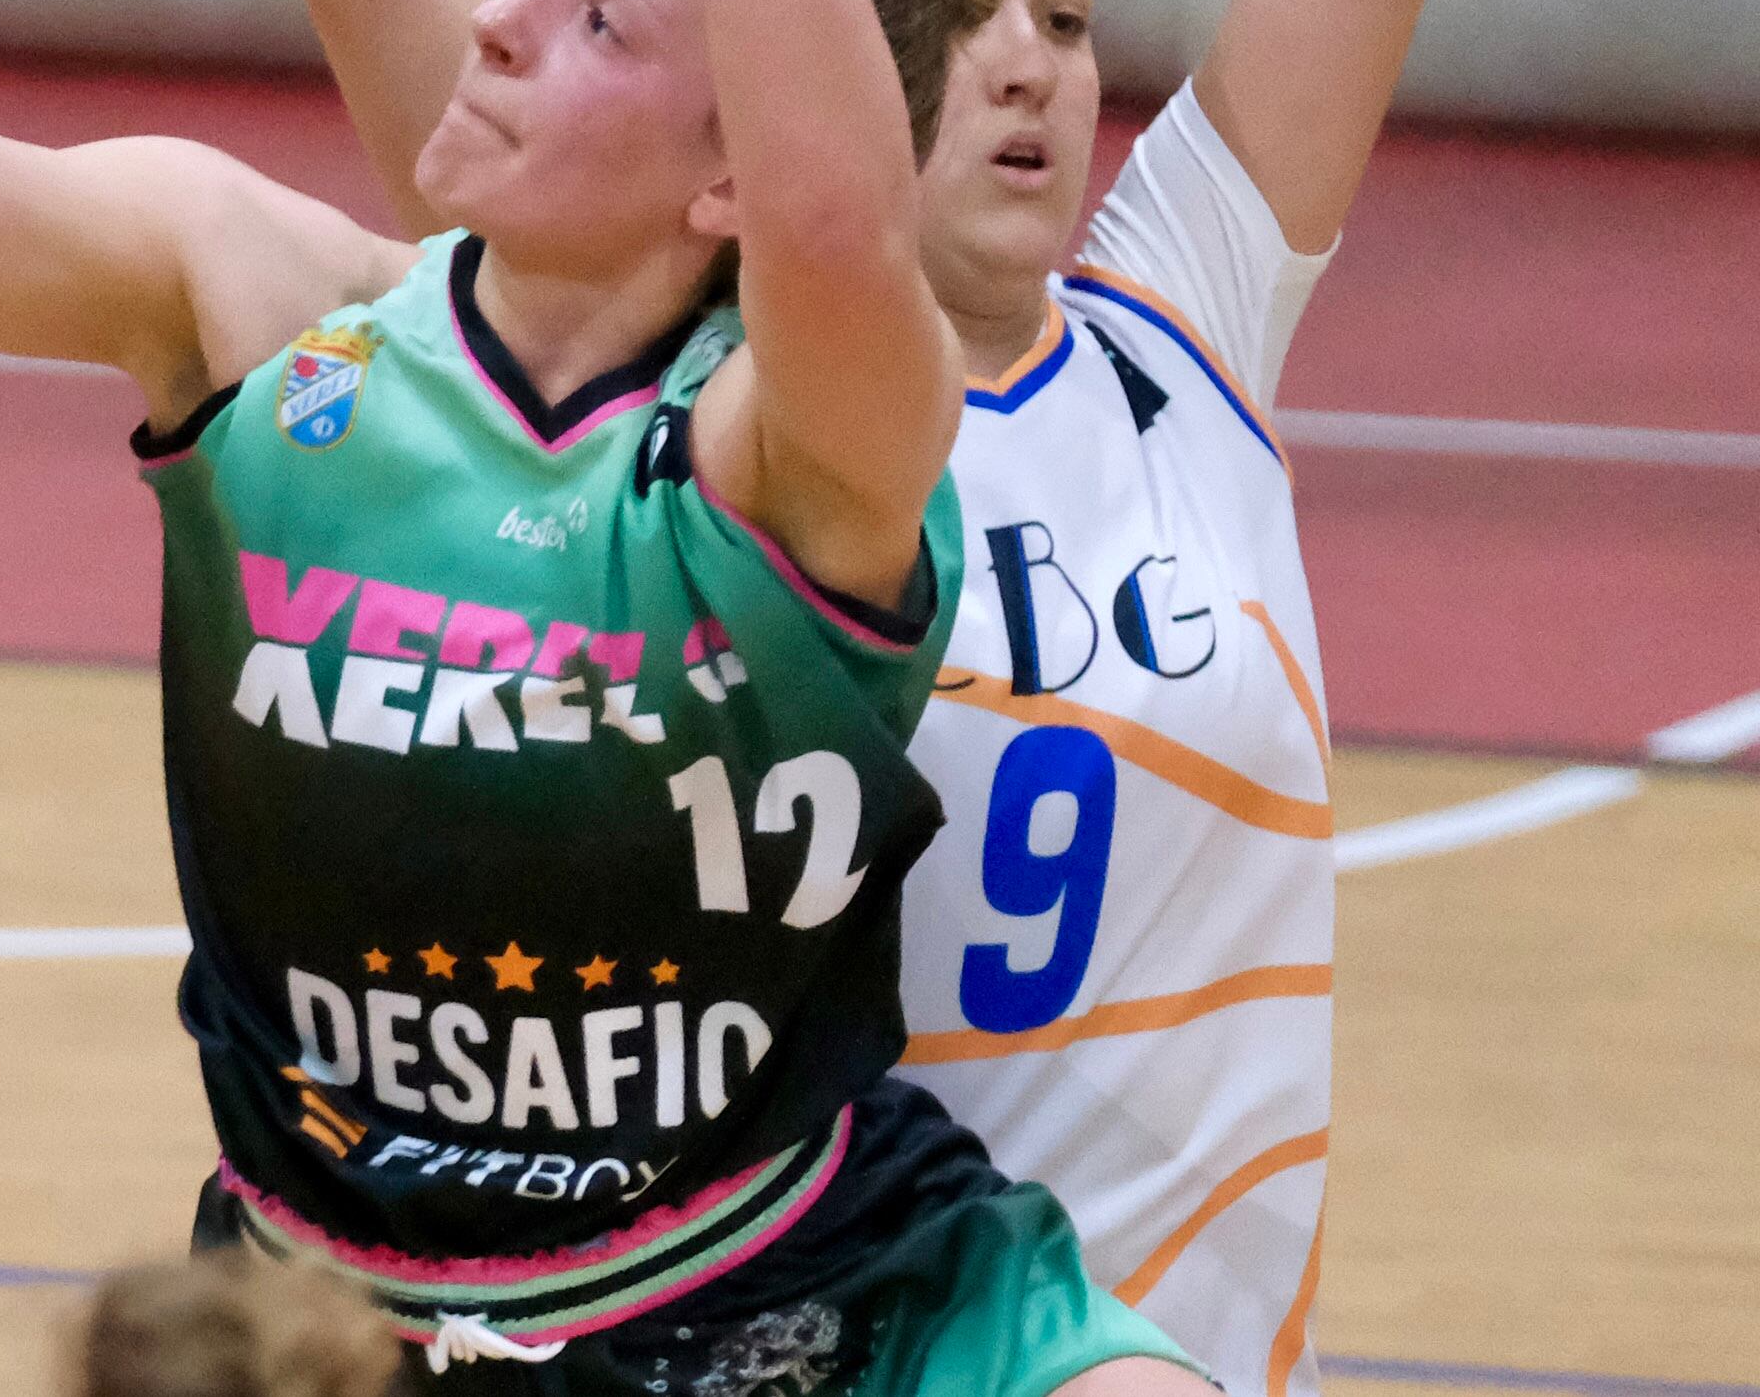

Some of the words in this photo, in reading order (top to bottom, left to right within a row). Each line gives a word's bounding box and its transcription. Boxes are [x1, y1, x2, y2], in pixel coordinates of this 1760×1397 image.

[934, 521, 1217, 696] BG
[668, 750, 871, 931] 12
[958, 724, 1117, 1035] 9
[287, 966, 774, 1131] DESAFIO
